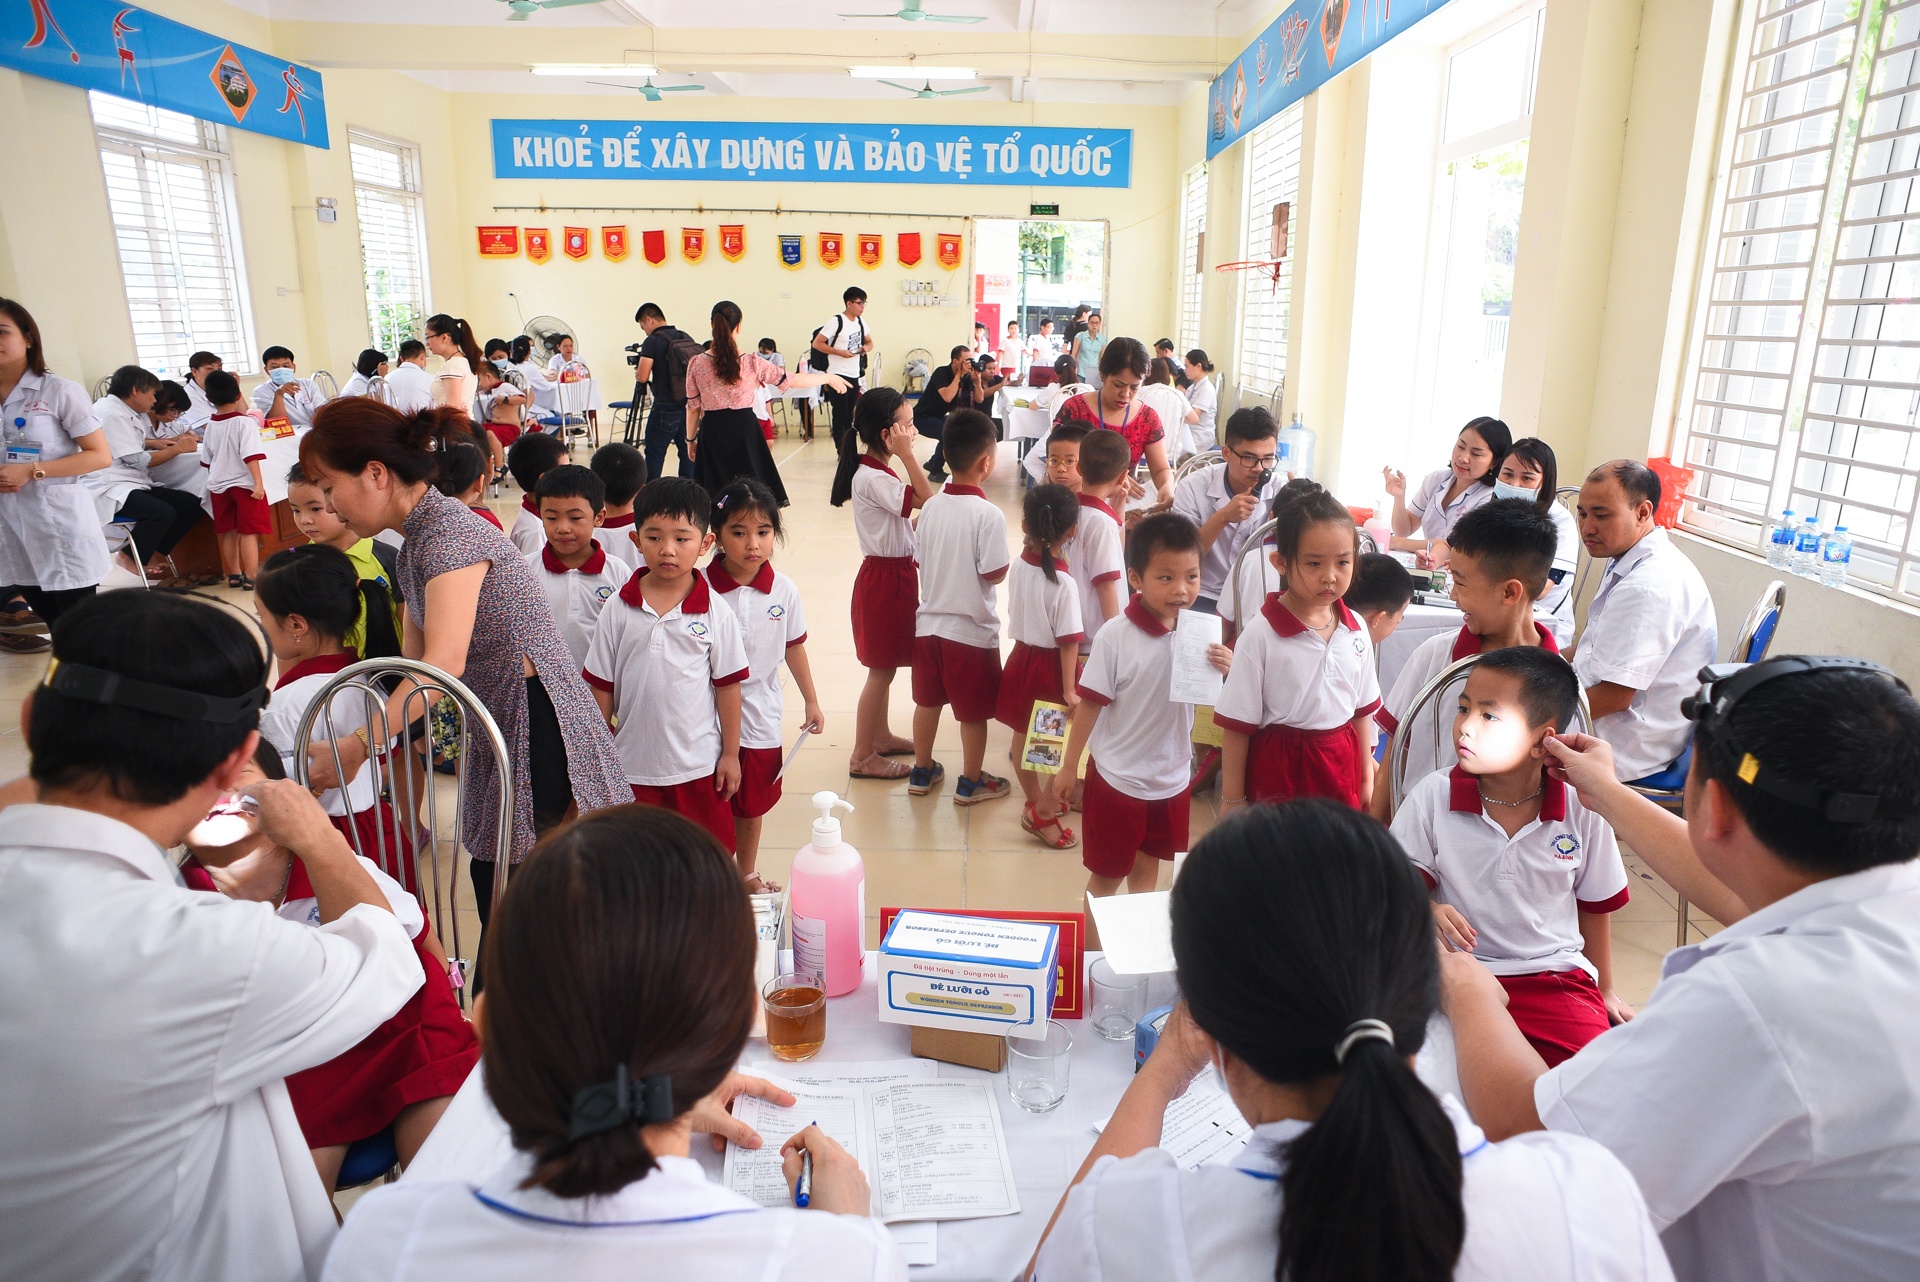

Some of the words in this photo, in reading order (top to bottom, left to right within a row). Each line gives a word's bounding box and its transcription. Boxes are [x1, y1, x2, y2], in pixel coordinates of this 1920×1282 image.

[513, 124, 593, 167] KHOẺ
[602, 125, 643, 168] ĐỂ
[651, 131, 710, 168] XÂY
[721, 136, 805, 176] DỰNG
[814, 133, 855, 171] VÀ
[864, 128, 926, 172] BẢO
[935, 136, 972, 179] VỆ
[982, 131, 1022, 174] TỔ
[1030, 134, 1112, 178] QUỐC
[905, 925, 957, 934] DEPRESSOR
[958, 930, 996, 938] TONGUE
[997, 934, 1038, 943] WOODEN
[936, 966, 954, 975] trùng
[963, 969, 982, 978] Dùng
[947, 984, 973, 994] LƯỠI
[919, 996, 945, 1004] WOODEN
[945, 999, 969, 1007] TONGUE
[969, 1002, 1003, 1010] DEPRESSOR
